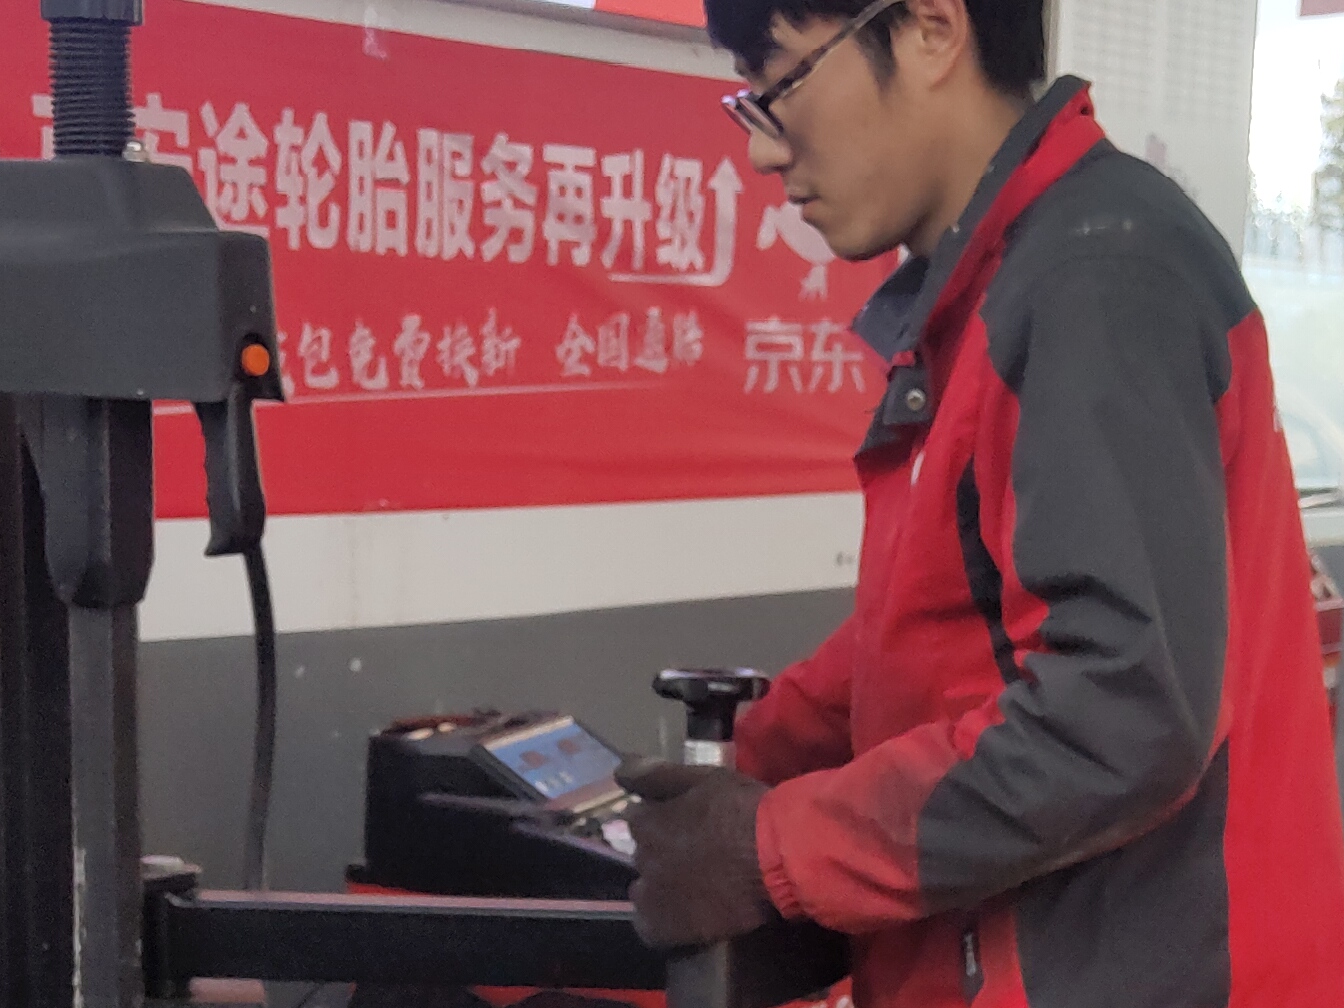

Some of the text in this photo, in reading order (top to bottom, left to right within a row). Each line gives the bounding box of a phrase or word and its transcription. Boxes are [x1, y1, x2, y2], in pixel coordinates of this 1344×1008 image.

[276, 307, 522, 397] 包免费换新
[744, 316, 866, 393] 京东
